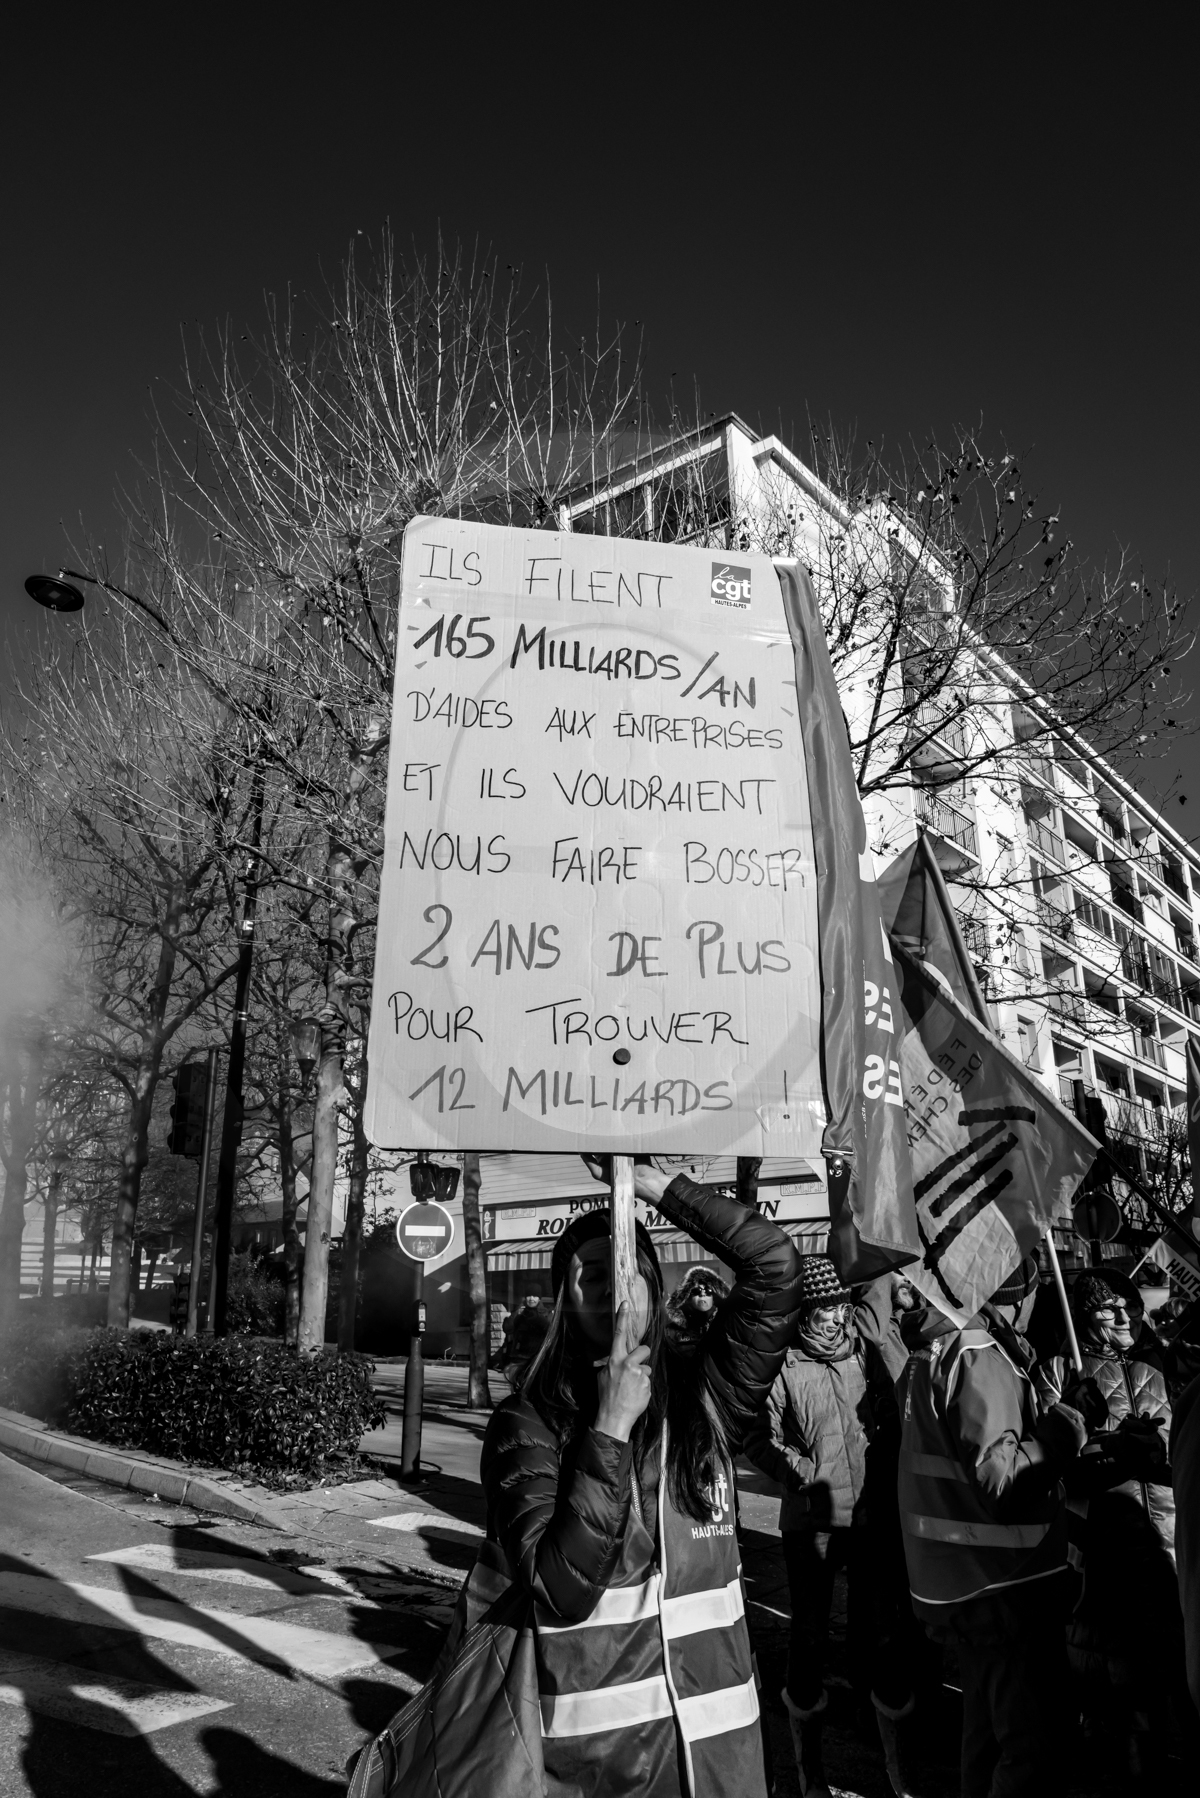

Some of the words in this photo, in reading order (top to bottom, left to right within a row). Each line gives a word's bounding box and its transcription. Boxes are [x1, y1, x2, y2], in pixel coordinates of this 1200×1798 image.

[419, 543, 483, 586] ILS
[525, 557, 673, 608] FILENT
[711, 578, 751, 601] cgt
[714, 599, 747, 610] HAUTES-ALPES
[413, 613, 495, 659] 165
[510, 624, 757, 709] MILLIARDS/AN
[407, 687, 513, 729] D'AIDES
[545, 707, 598, 742] AUX
[613, 712, 783, 750] ENTREPRISES
[403, 763, 441, 801] ET
[480, 768, 527, 800] ILS
[553, 769, 776, 815] VOUDRAIENT
[400, 830, 511, 875] NOUS
[552, 836, 643, 885] FAIRE
[683, 841, 806, 892] BOSSER
[410, 903, 453, 969] 2
[471, 919, 561, 976] ANS
[606, 931, 669, 978] DE
[685, 920, 792, 979] PLUS
[388, 990, 484, 1044] POUR
[525, 998, 750, 1046] TROUVER
[409, 1064, 476, 1113] 12
[502, 1066, 734, 1116] MILLIARDS
[783, 1069, 790, 1120] !
